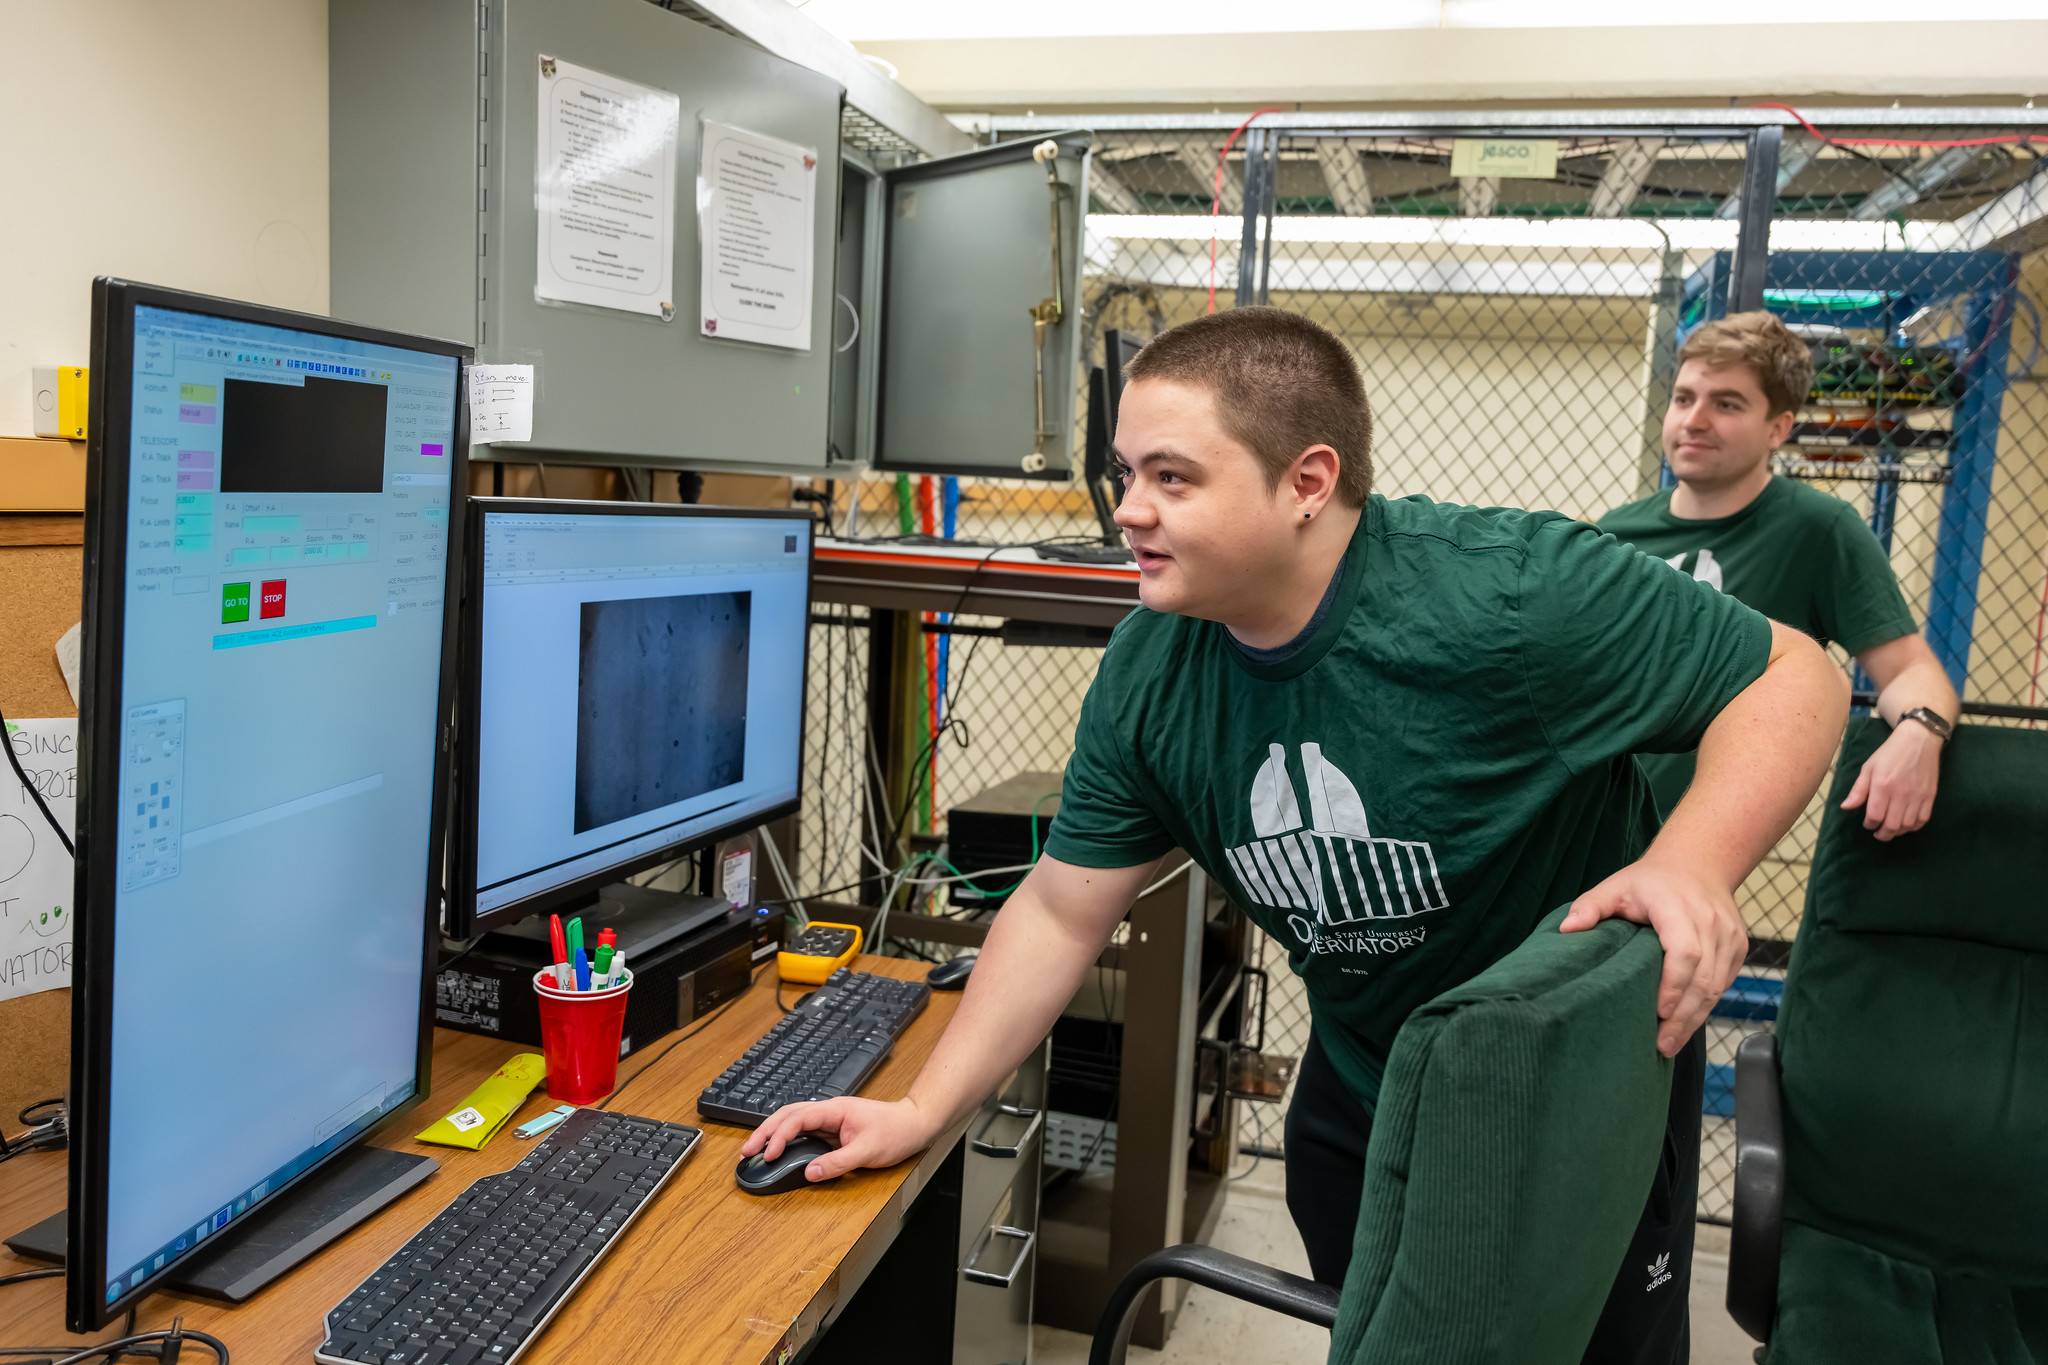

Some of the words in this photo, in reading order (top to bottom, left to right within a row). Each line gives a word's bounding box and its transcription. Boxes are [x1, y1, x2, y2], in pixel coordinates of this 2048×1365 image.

[225, 599, 237, 608] GO
[239, 597, 249, 606] TO
[264, 593, 283, 604] STOP
[12, 731, 79, 756] SINC
[1366, 925, 1427, 939] UNIVERSITY
[1645, 1271, 1673, 1293] adidas
